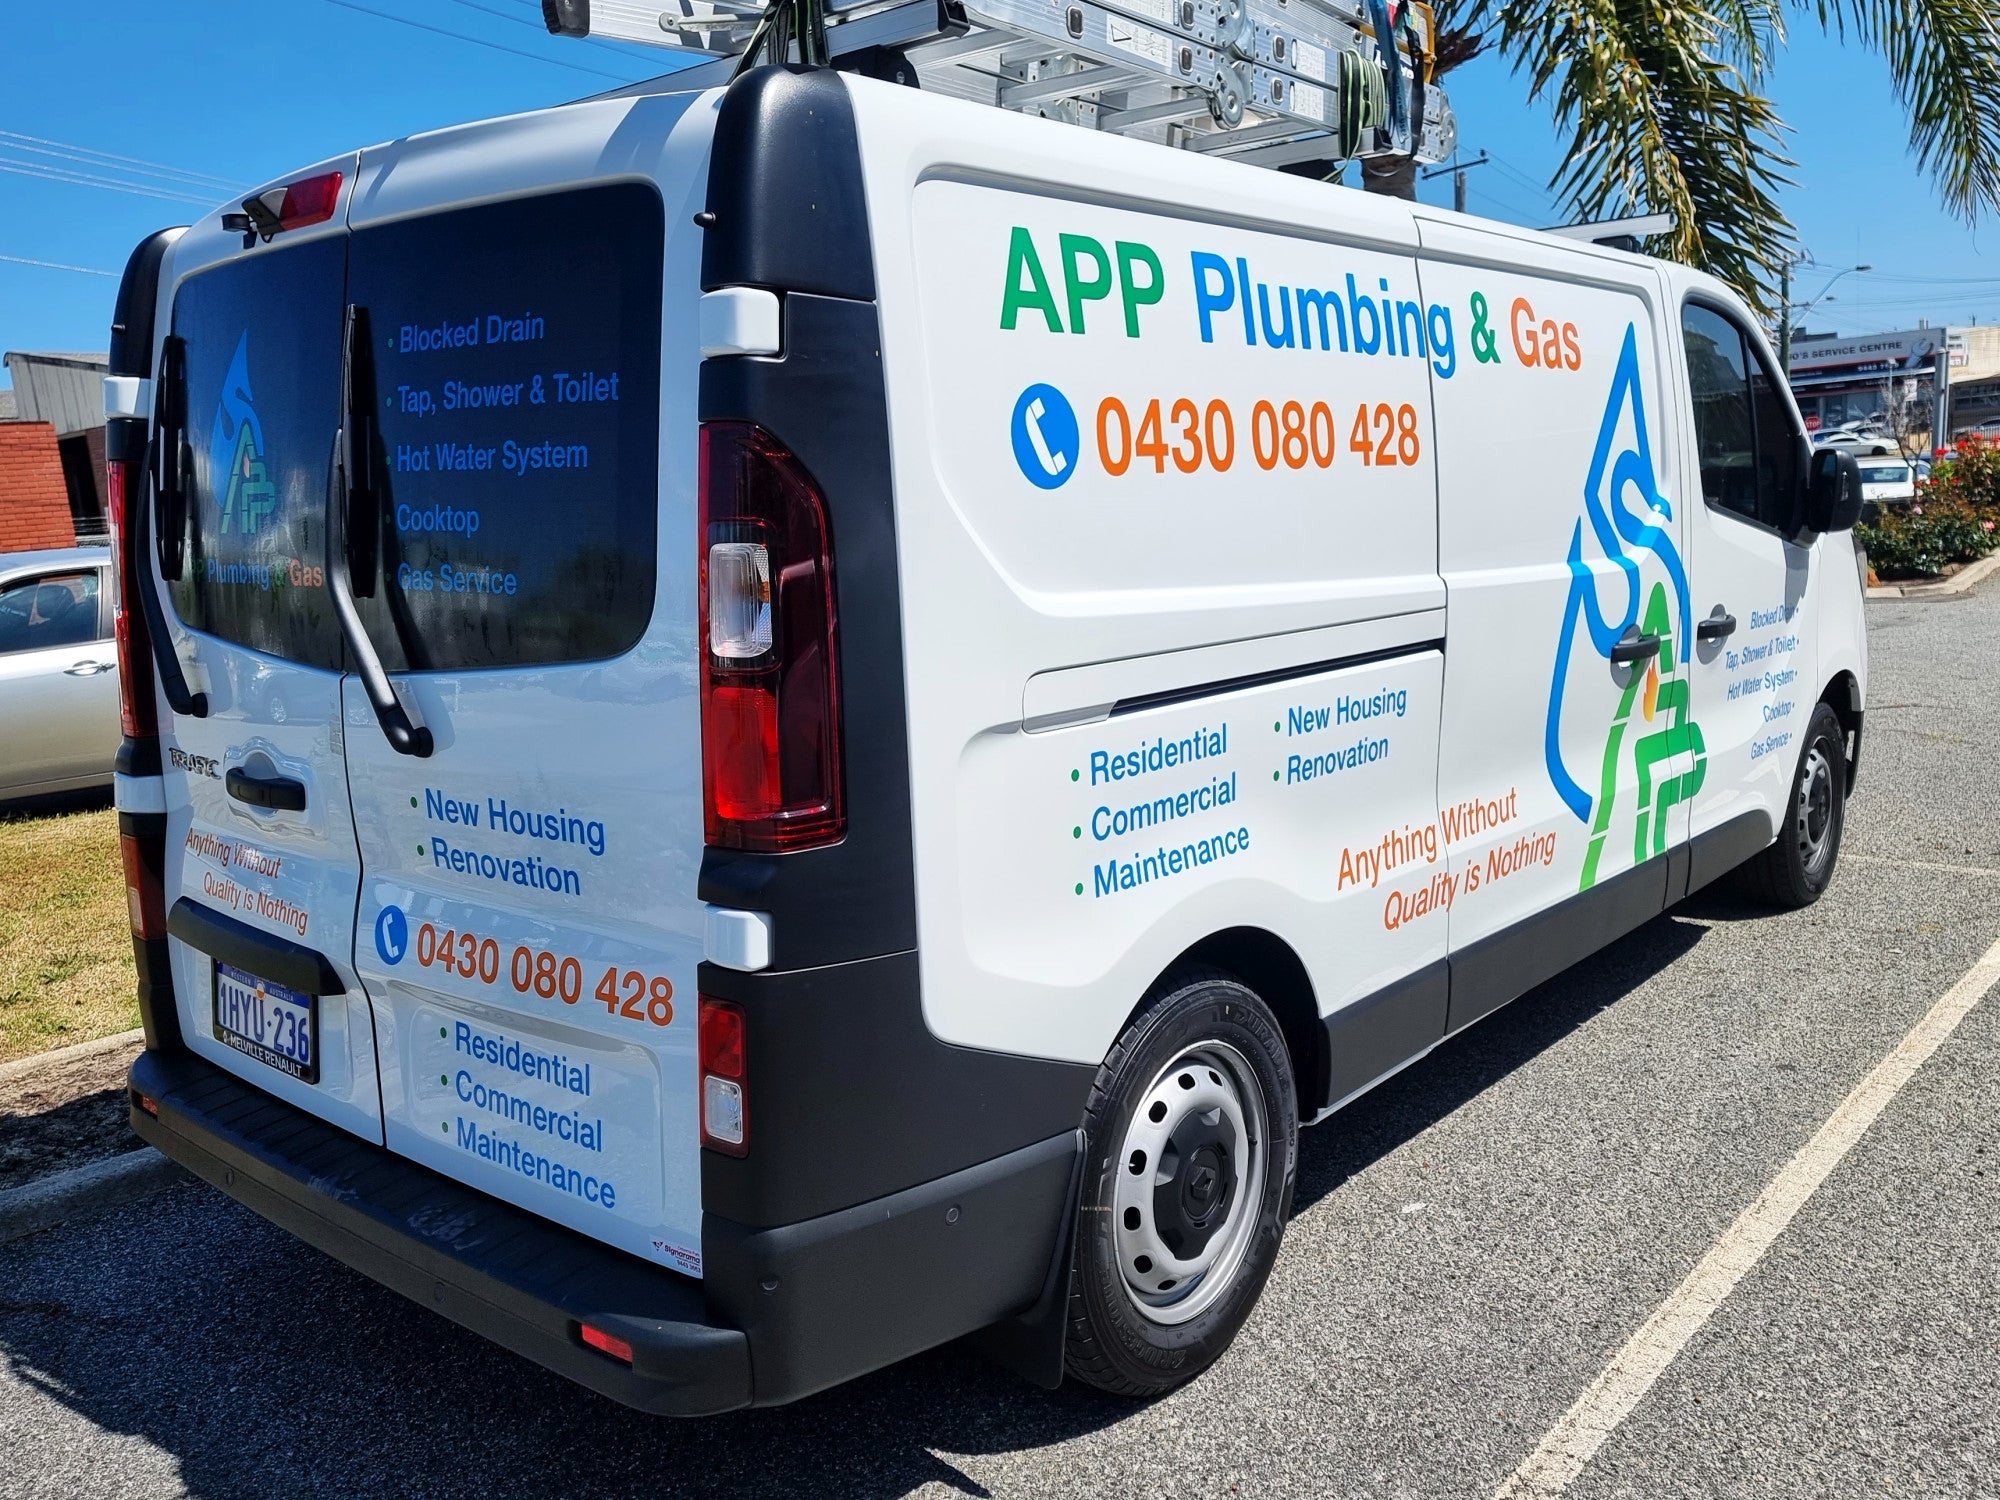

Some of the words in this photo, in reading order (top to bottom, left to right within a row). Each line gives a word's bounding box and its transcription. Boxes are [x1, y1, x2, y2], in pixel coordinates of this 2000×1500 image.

[999, 226, 1165, 338] APP
[1190, 250, 1456, 379] Plumbing
[1470, 291, 1502, 363] &
[1510, 297, 1581, 371] Gas
[400, 318, 478, 353] Blocked
[486, 312, 544, 344] Drain
[1790, 352, 1808, 361] O'S
[1812, 346, 1856, 359] SERVICE
[1859, 341, 1903, 353] CENTRE
[398, 385, 437, 417] Tap,
[443, 378, 523, 410] Shower
[529, 376, 545, 403] &
[553, 372, 619, 402] Toilet
[398, 445, 431, 472] Hot
[435, 443, 496, 471] Water
[502, 440, 588, 475] System
[1096, 396, 1234, 476] 0430
[1251, 399, 1335, 470] 080
[1350, 403, 1420, 466] 428
[397, 504, 479, 538] Cooktop
[208, 558, 270, 591] Plumbing
[290, 559, 323, 587] Gas
[398, 562, 434, 591] Gas
[440, 564, 517, 596] Service
[1750, 608, 1778, 630] Blocked
[1725, 651, 1739, 672] Tap,
[1741, 645, 1767, 666] Shower
[1768, 639, 1773, 657] &
[1775, 636, 1796, 655] Toilet
[1727, 679, 1741, 702] Hot
[1742, 678, 1763, 697] Water
[1764, 670, 1794, 692] System
[1288, 707, 1330, 737] New
[1337, 687, 1407, 726] Housing
[1763, 701, 1792, 723] Cooktop
[1090, 723, 1228, 786] Residential
[1287, 734, 1389, 785] Renovation
[1750, 740, 1765, 760] Gas
[1765, 732, 1789, 755] Service
[426, 788, 479, 828] New
[489, 798, 606, 857] Housing
[1091, 772, 1237, 841] Commercial
[185, 827, 231, 867] Anything
[234, 842, 281, 879] Without
[1094, 824, 1250, 898] Maintenance
[1338, 820, 1437, 891] Anything
[1441, 787, 1517, 846] Without
[433, 837, 581, 896] Renovation
[1384, 873, 1459, 932] Quality
[1464, 860, 1480, 895] is
[1486, 831, 1557, 884] Nothing
[204, 872, 242, 910] Quality
[243, 889, 254, 911] is
[256, 892, 308, 936] Nothing
[416, 922, 500, 985] 0430
[510, 946, 582, 1006] 080
[595, 966, 674, 1026] 428
[230, 1034, 264, 1060] MELVILLE
[265, 1052, 302, 1077] RENAULT
[456, 1022, 591, 1096] Residential
[456, 1070, 602, 1152] Commercial
[457, 1117, 616, 1209] Maintenance
[664, 1245, 700, 1263] Signarama
